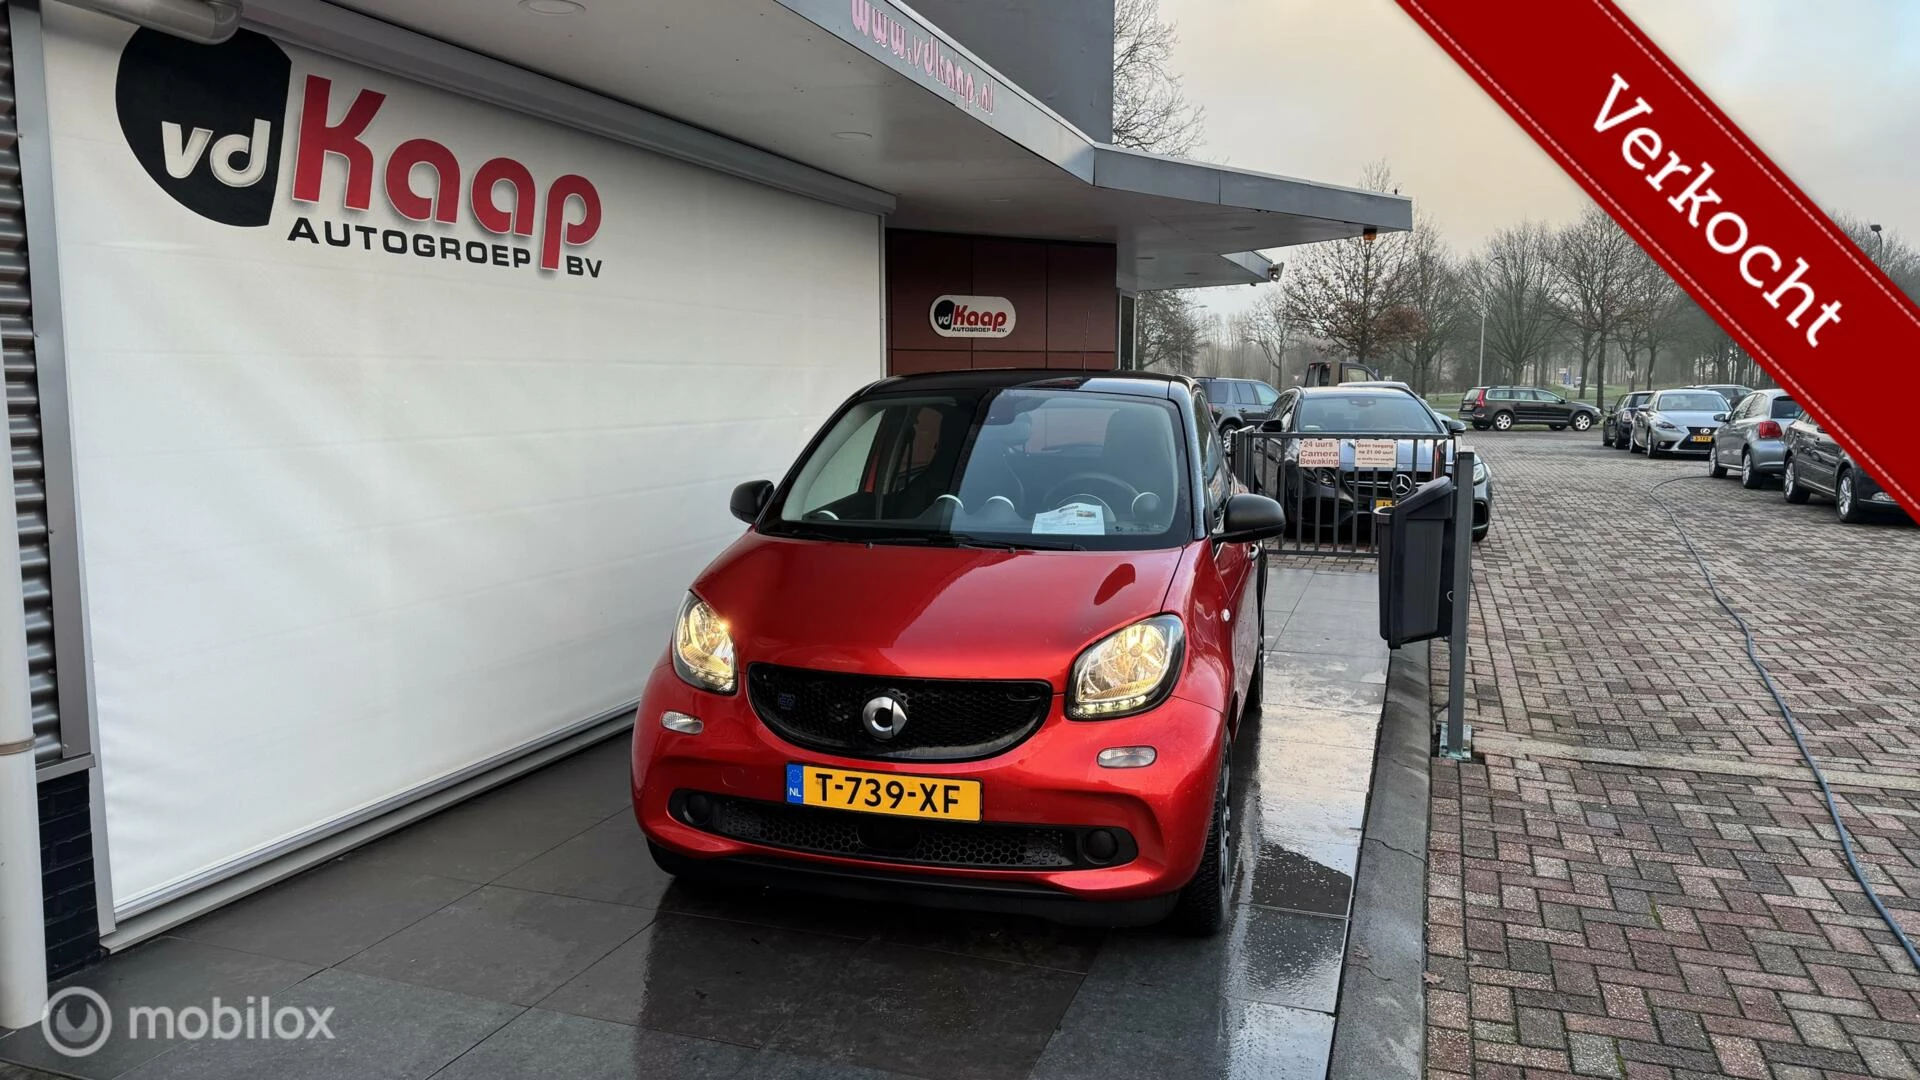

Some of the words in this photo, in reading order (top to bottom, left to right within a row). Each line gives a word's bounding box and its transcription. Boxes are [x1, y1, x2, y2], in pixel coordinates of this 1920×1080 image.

[851, 0, 994, 115] www.vdkaap.nl
[162, 118, 270, 187] vd
[292, 74, 602, 271] Kaap
[287, 217, 531, 268] AUTOGROEP
[566, 255, 602, 278] BV
[938, 313, 951, 325] vd
[953, 304, 1007, 332] Kaap
[1300, 458, 1338, 466] Bewaking
[1303, 440, 1313, 448] 24
[1315, 440, 1333, 448] uurs
[789, 787, 801, 797] NL
[815, 772, 960, 814] T-739-XF
